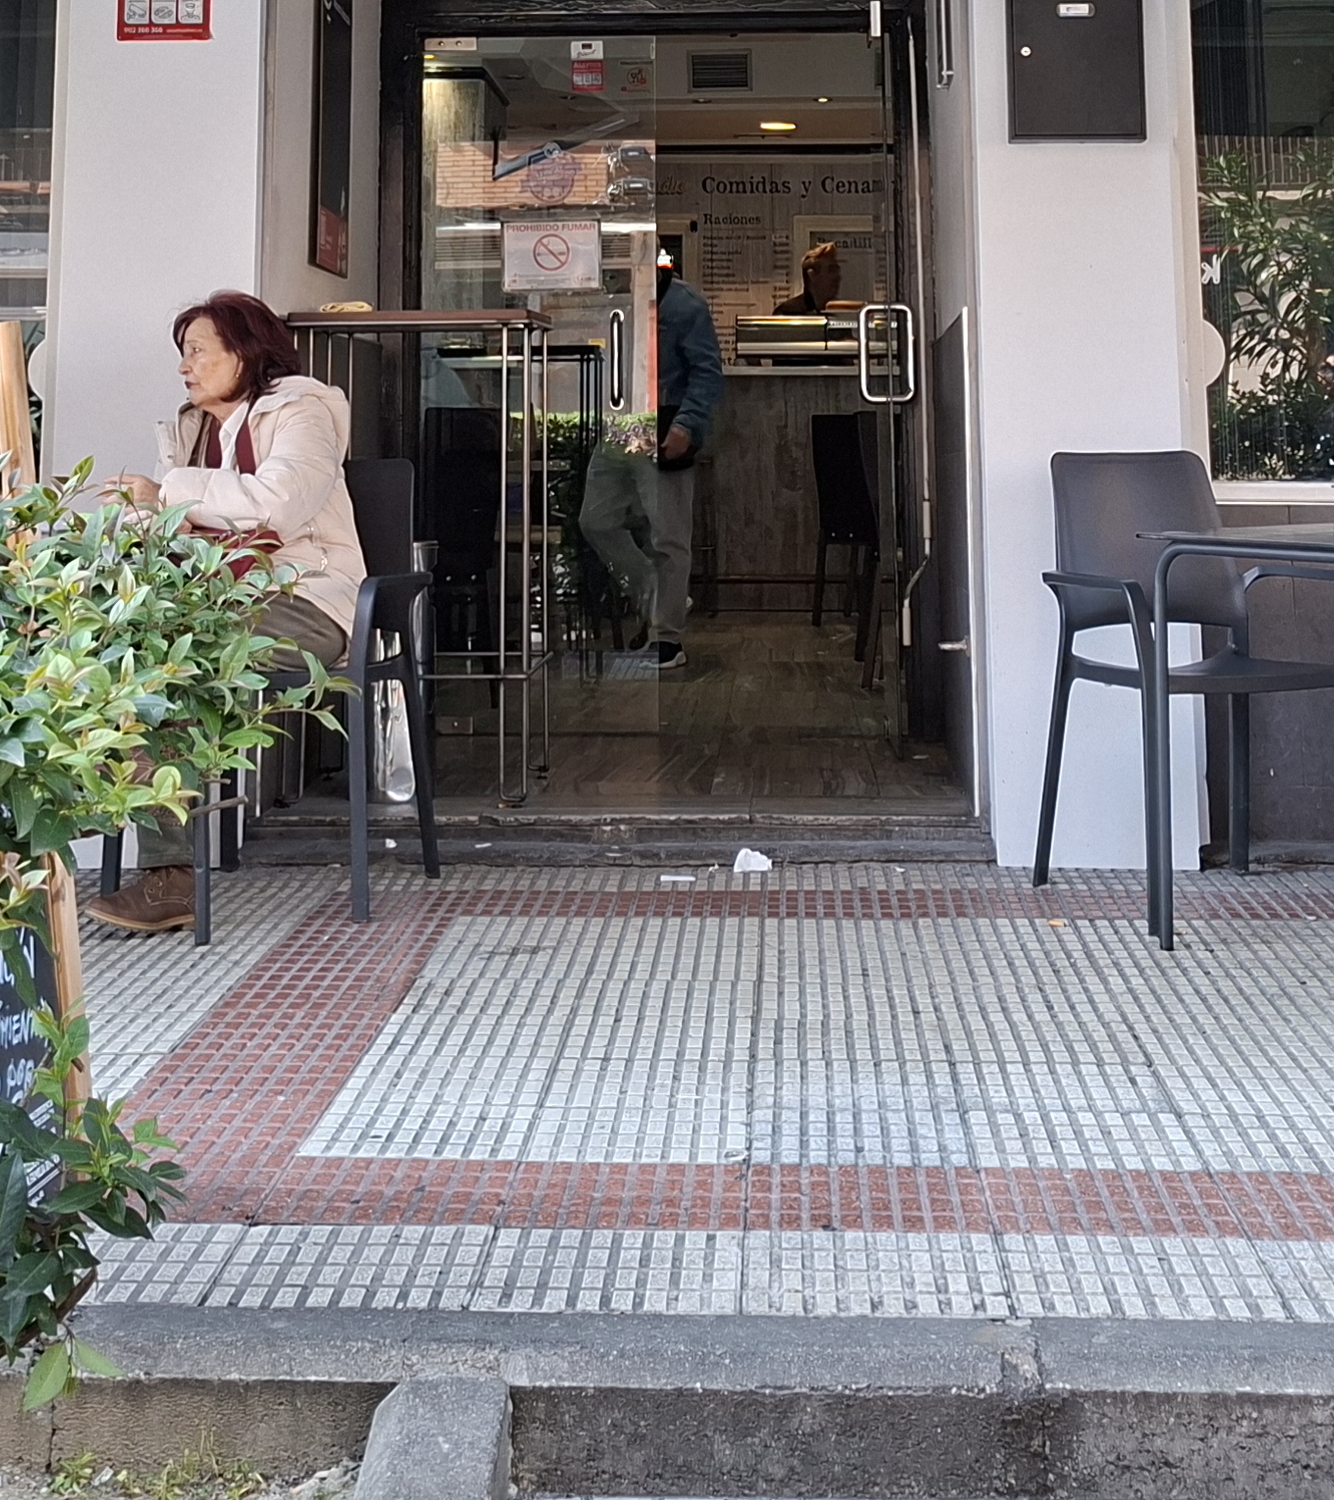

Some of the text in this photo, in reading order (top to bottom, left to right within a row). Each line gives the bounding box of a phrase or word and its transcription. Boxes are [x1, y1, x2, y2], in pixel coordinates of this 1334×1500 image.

[702, 175, 792, 195] Comidas
[800, 179, 813, 199] y
[820, 175, 884, 194] Cena
[703, 213, 762, 226] Raciones
[506, 222, 596, 233] PROHIBIDO FUMAR
